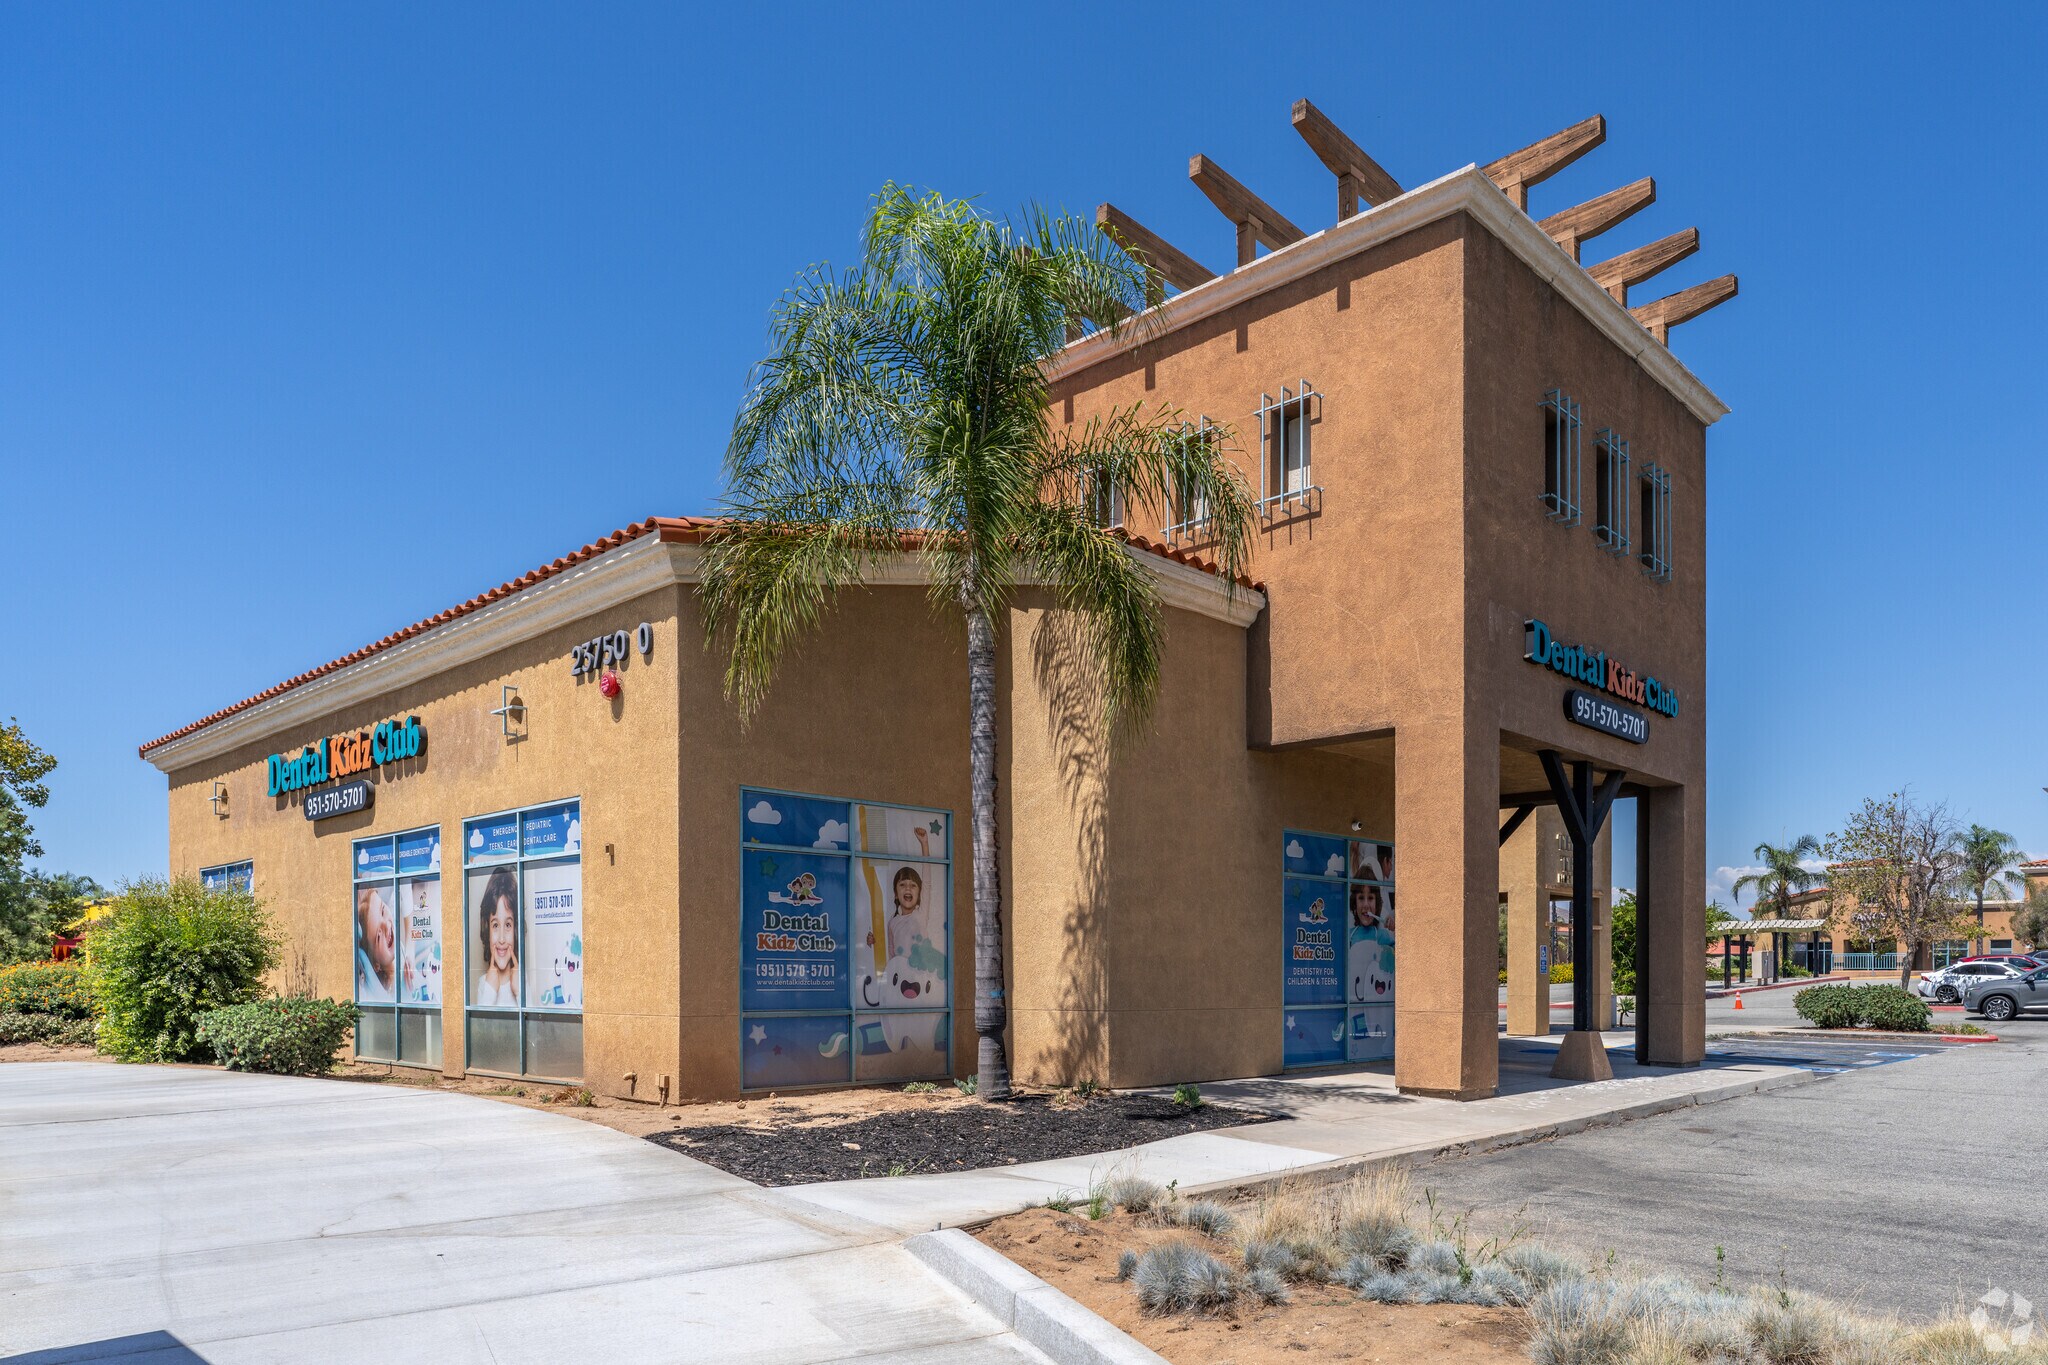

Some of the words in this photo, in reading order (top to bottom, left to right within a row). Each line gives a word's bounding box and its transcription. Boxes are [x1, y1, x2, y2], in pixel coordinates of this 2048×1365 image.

[571, 630, 630, 676] 23750
[1524, 618, 1605, 689] Dental
[1607, 658, 1645, 705] Kidz
[1645, 676, 1679, 719] Club
[1577, 695, 1646, 740] 951-570-5701
[267, 736, 328, 798] Dental
[329, 731, 372, 779] Kidz
[373, 715, 425, 766] Club
[307, 785, 364, 817] 951-570-5701
[492, 825, 518, 837] EMERGENC
[526, 819, 552, 831] PEDIATRIC
[489, 842, 504, 851] TEENS
[523, 836, 542, 846] DENTAL
[543, 833, 557, 843] CARE
[412, 915, 431, 927] Dental
[763, 910, 829, 932] Dental
[411, 930, 422, 939] Kidz
[422, 929, 433, 939] Club
[756, 932, 797, 951] Kidz
[797, 934, 836, 952] Club
[1296, 927, 1332, 945] Dental
[1292, 945, 1314, 960] Kidz
[1314, 945, 1336, 961] Club
[756, 963, 785, 977] (951)
[1292, 967, 1322, 976] DENTISTRY
[1323, 967, 1335, 976] FOR
[1287, 977, 1315, 986] CHILDREN
[1315, 977, 1320, 986] &
[1321, 977, 1338, 986] TEENS
